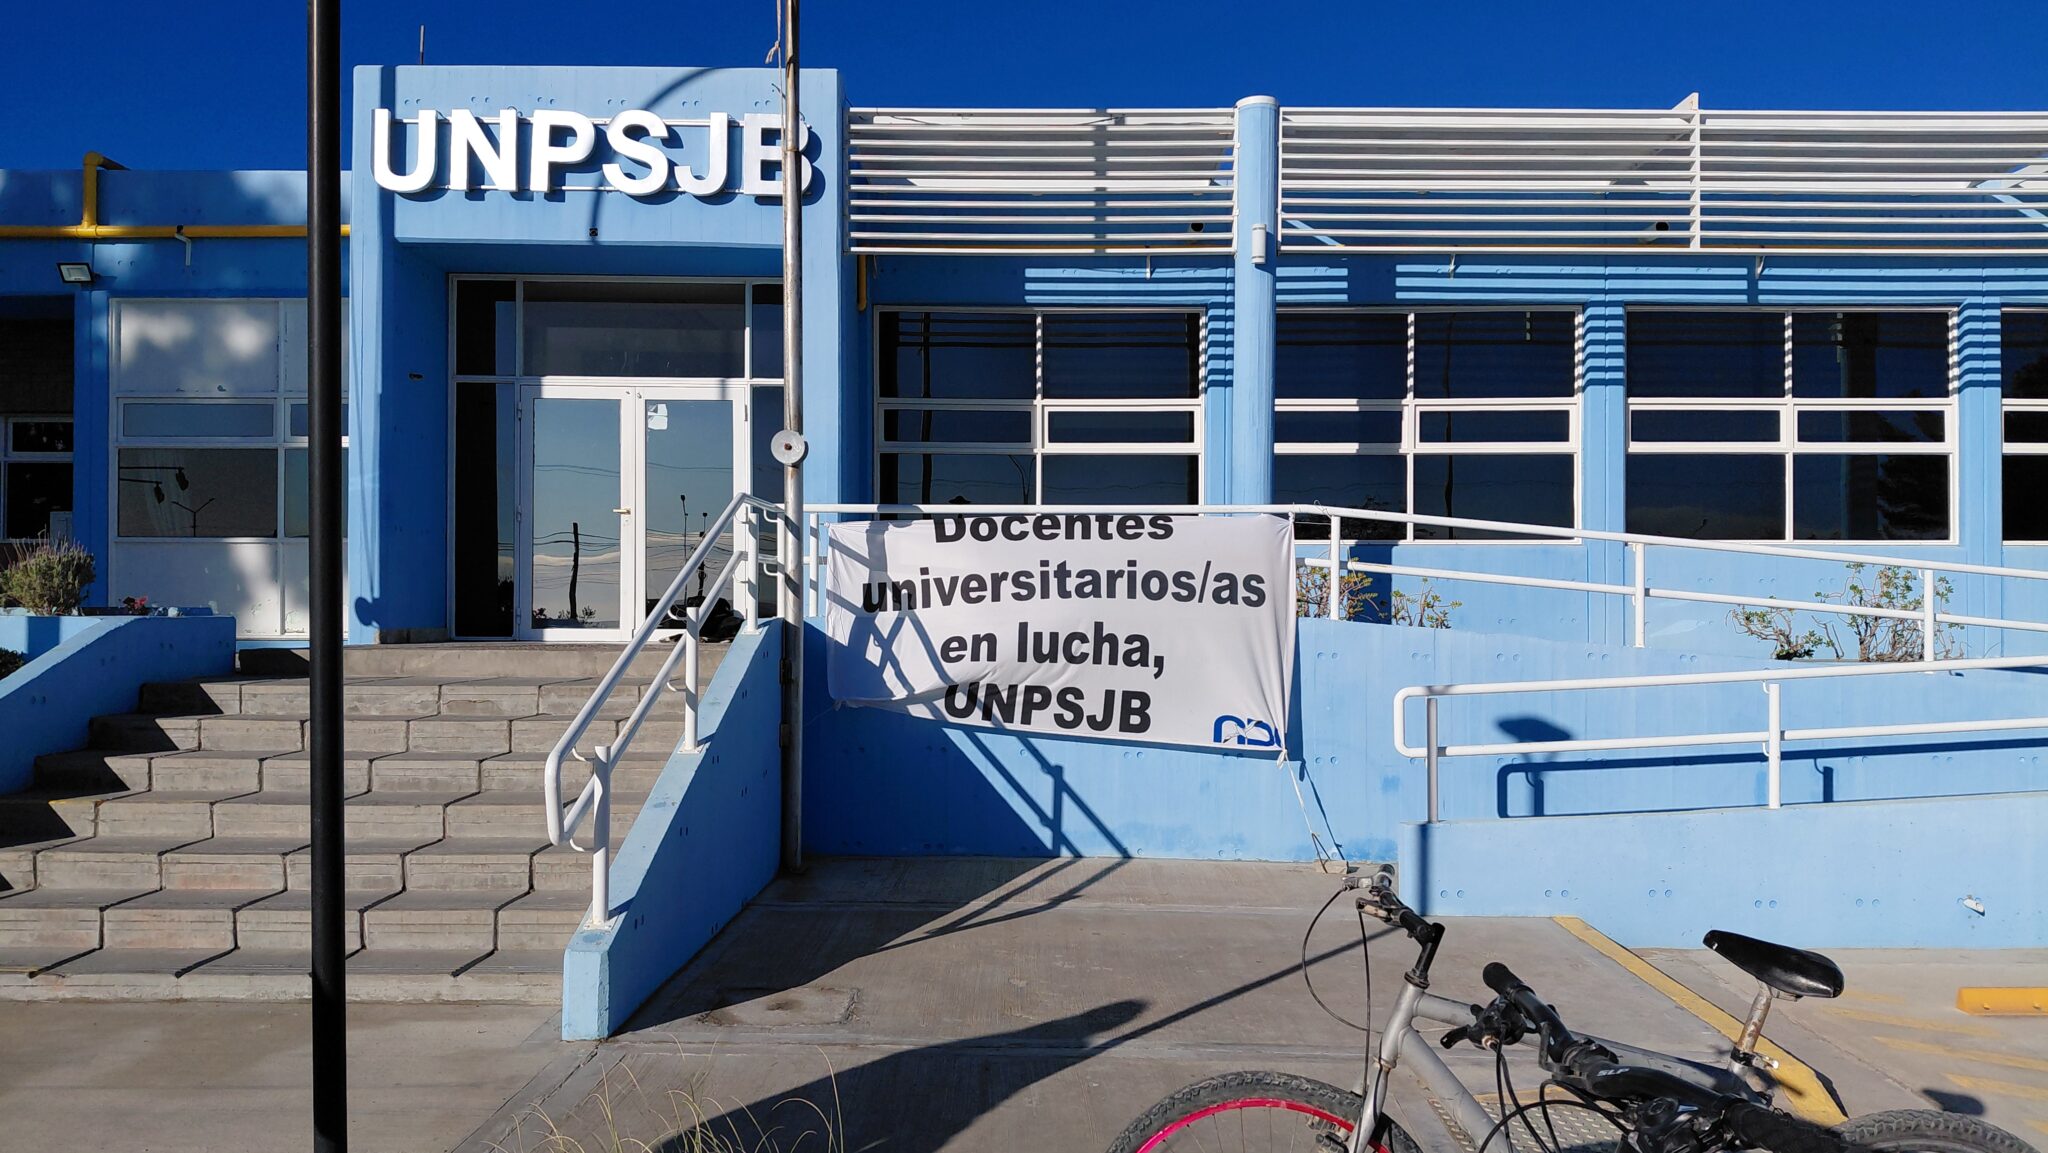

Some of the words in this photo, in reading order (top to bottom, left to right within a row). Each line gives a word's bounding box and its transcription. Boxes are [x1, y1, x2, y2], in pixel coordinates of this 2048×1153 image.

[371, 108, 813, 196] UNPSJB
[933, 514, 1174, 543] Docentes
[862, 560, 1267, 613] universitarios/as
[940, 632, 997, 663] en
[1017, 621, 1165, 680] lucha,
[944, 681, 1152, 734] UNPSJB
